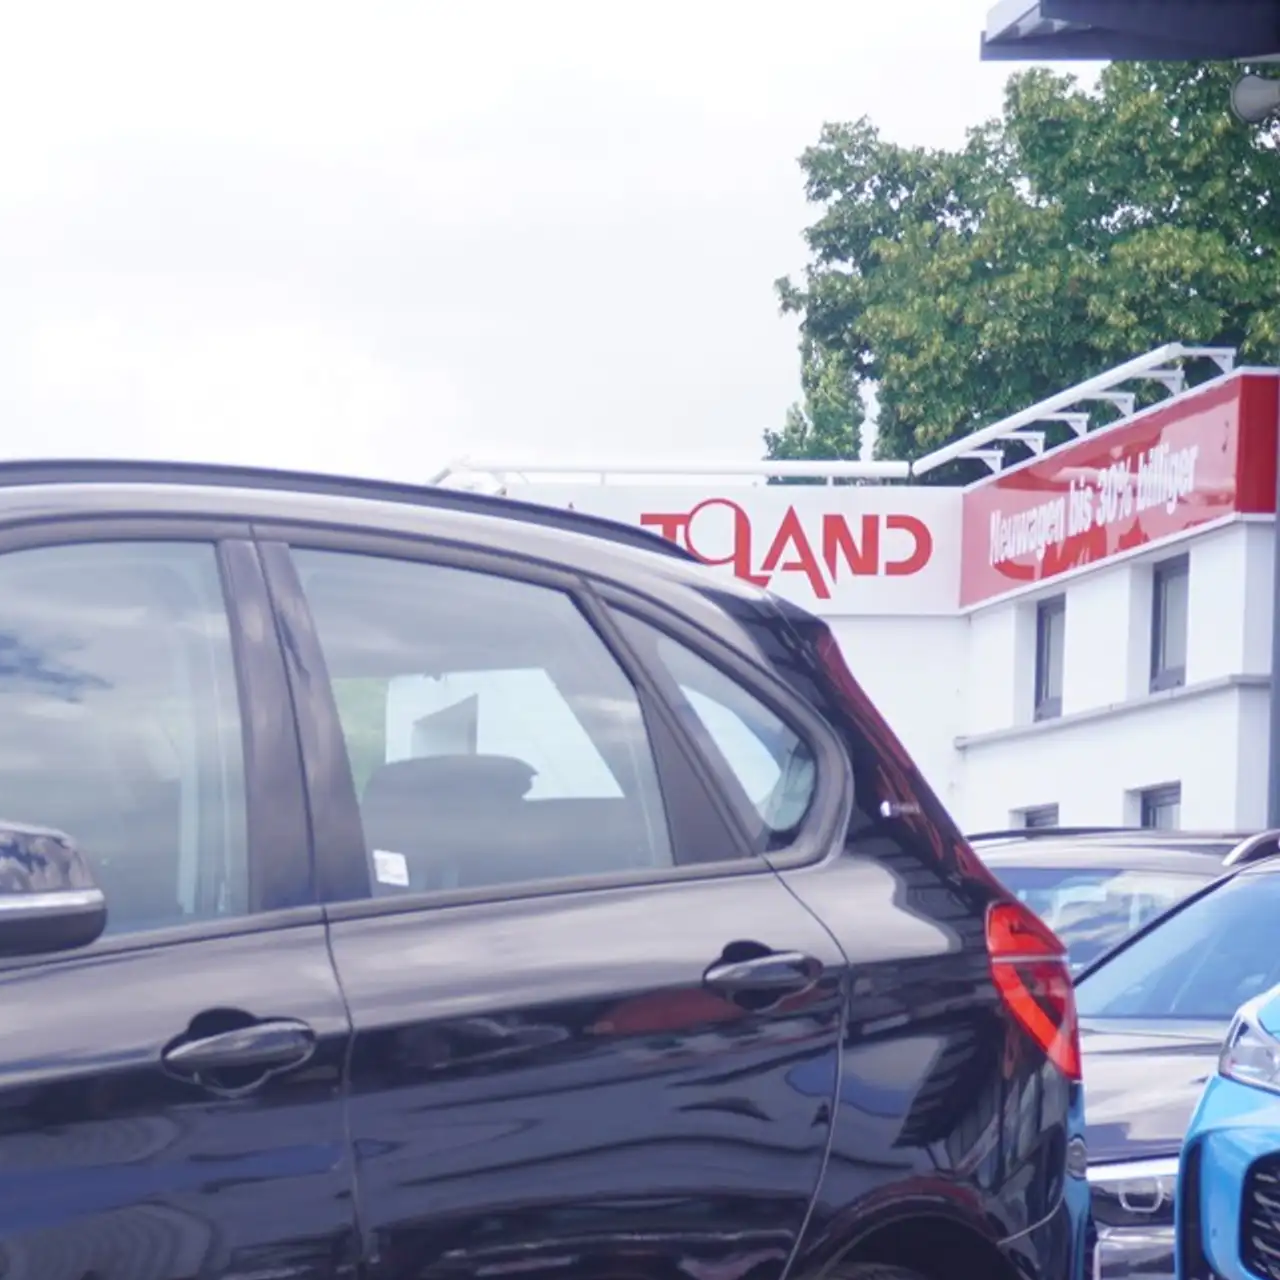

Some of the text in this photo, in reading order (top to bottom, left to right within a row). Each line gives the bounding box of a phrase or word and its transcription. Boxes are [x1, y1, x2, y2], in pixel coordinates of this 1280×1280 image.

[990, 443, 1198, 566] Neuwagen bis 30% billiger
